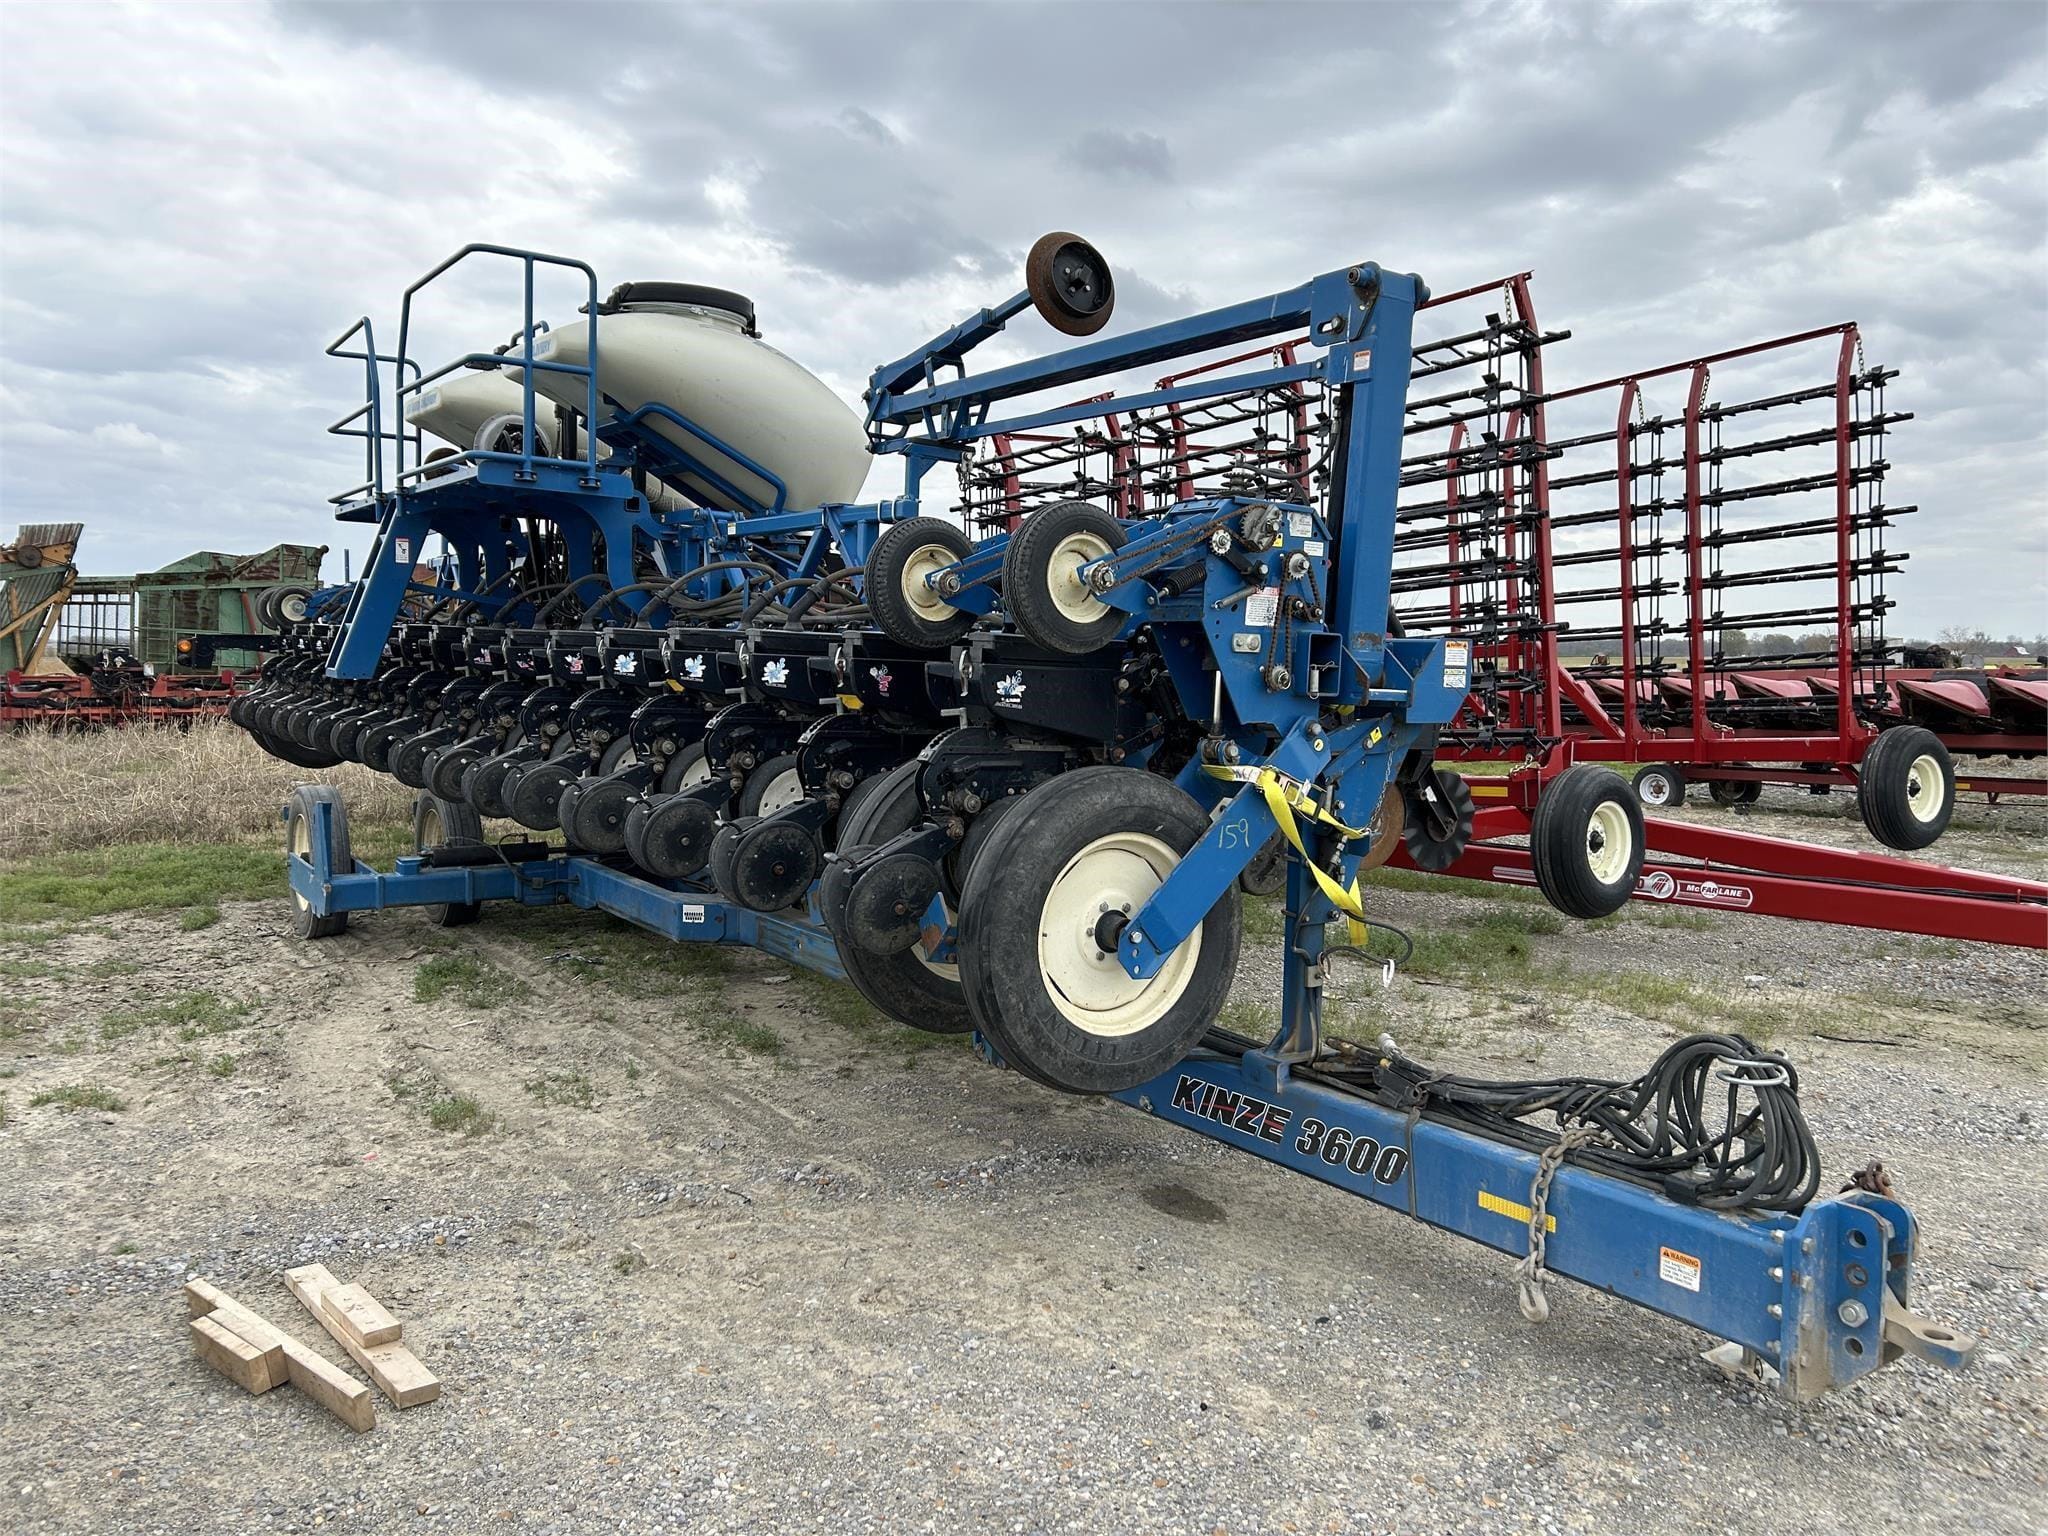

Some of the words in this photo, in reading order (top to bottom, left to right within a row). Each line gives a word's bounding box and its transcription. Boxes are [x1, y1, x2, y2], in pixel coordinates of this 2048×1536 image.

[1218, 818, 1250, 849] 159
[1171, 1074, 1293, 1144] KINZE
[1295, 1118, 1408, 1185] 3600
[1670, 1251, 1699, 1267] WARNING
